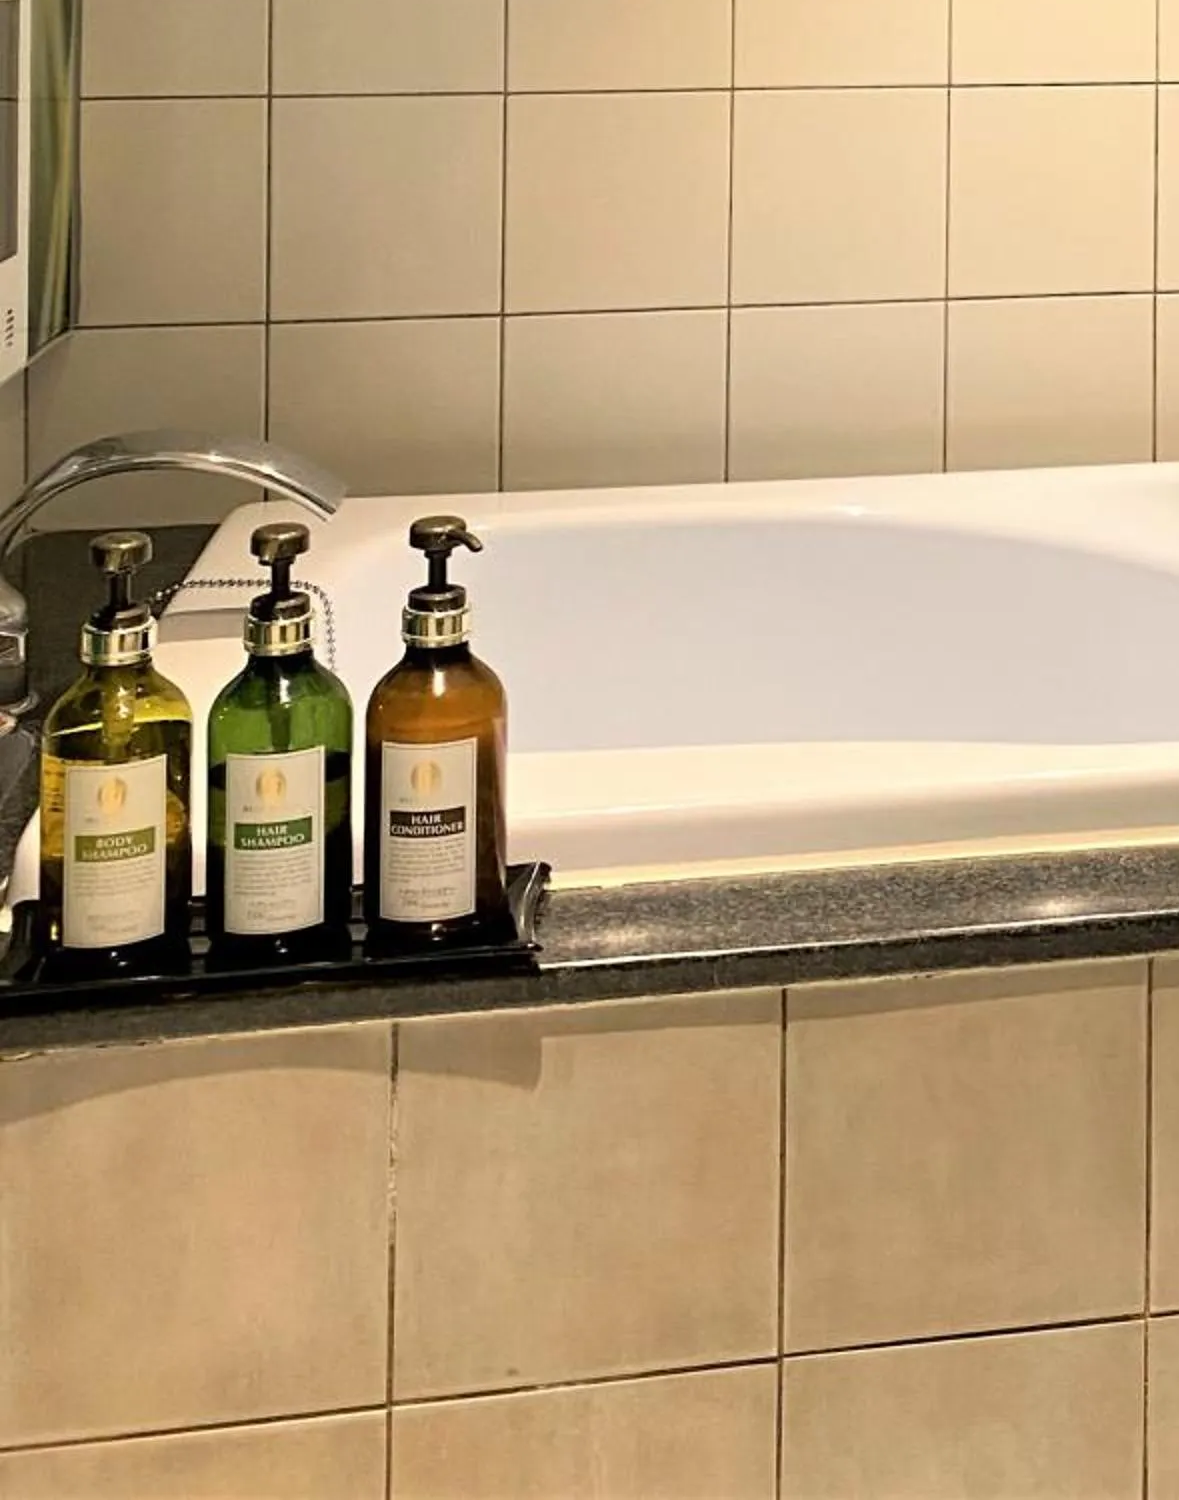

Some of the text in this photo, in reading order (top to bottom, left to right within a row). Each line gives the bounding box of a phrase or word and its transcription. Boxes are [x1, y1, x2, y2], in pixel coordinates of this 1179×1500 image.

[411, 813, 441, 825] HAIR
[256, 825, 288, 837] HAIR
[391, 820, 463, 835] CONDITIONER
[95, 836, 133, 849] BODY
[240, 833, 305, 848] SHAMPOO
[82, 843, 148, 861] SHAMPOO
